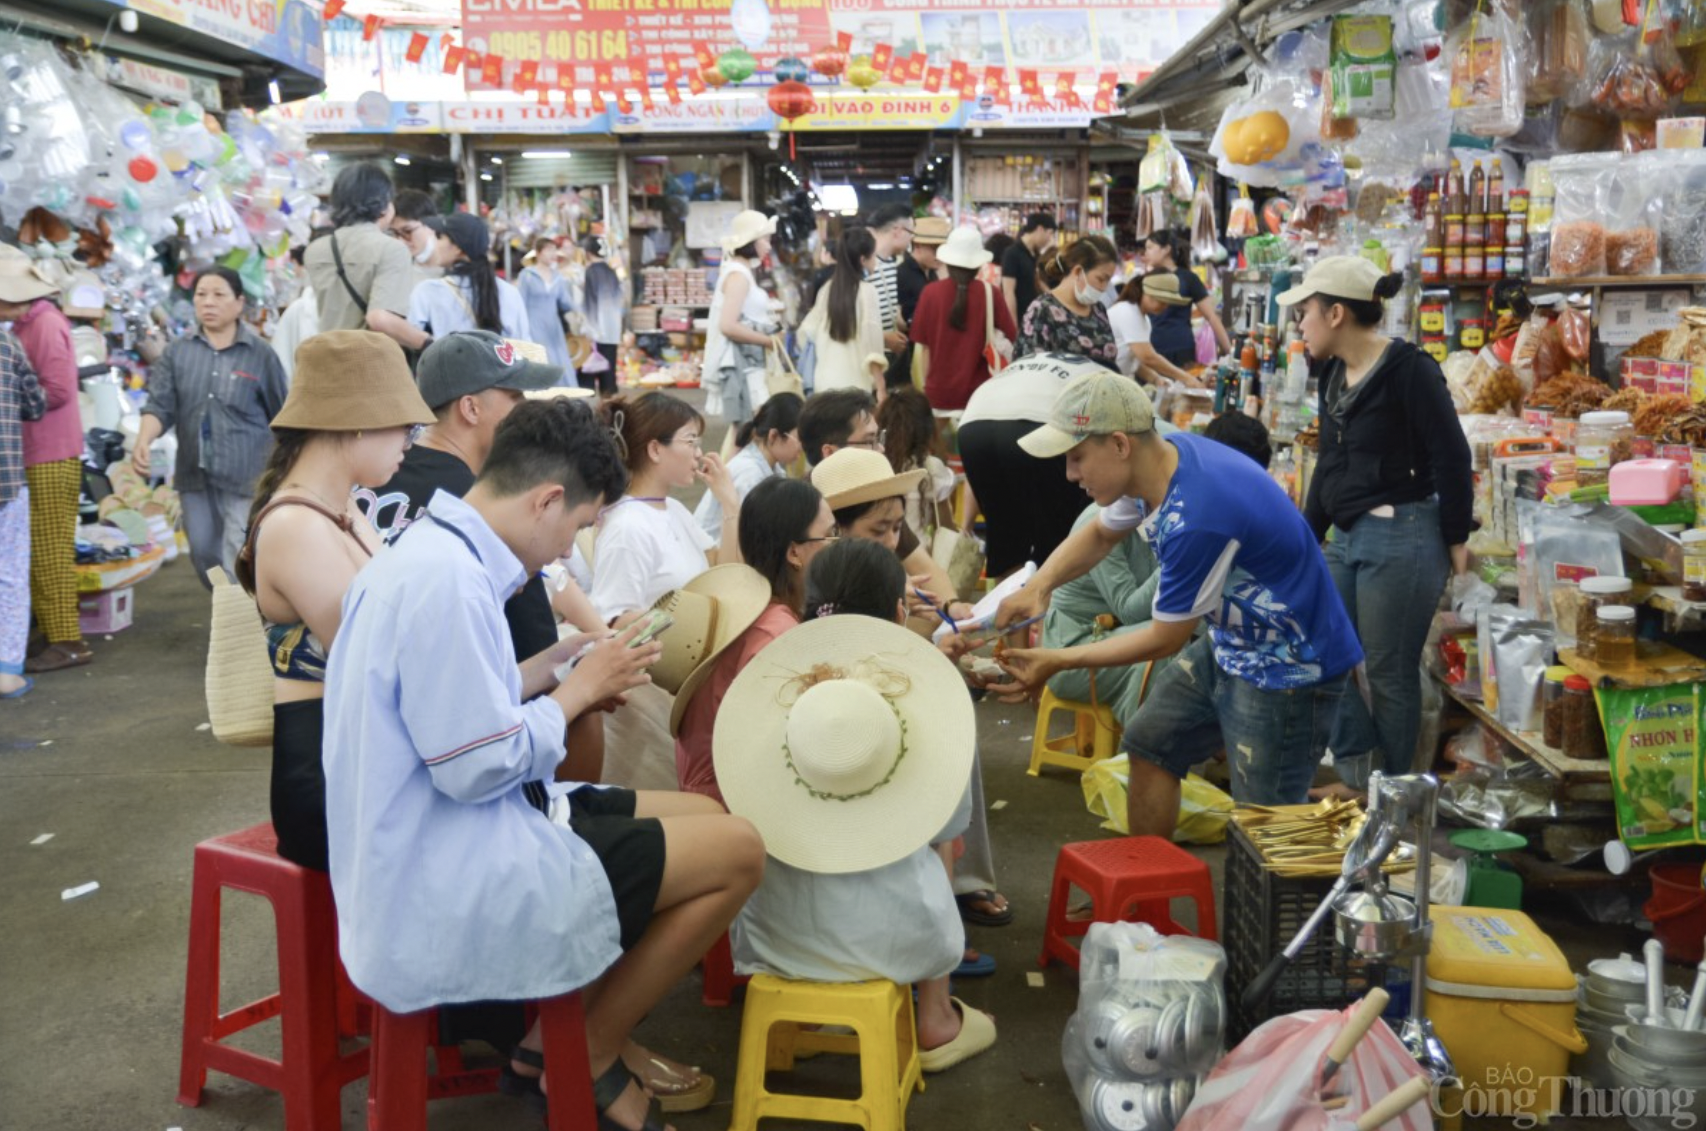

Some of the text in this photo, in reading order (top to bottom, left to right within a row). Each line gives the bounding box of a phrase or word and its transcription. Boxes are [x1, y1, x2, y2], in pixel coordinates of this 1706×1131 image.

[489, 29, 627, 60] 0905 40 61 64
[449, 107, 504, 121] CHỊ
[940, 102, 951, 115] 6
